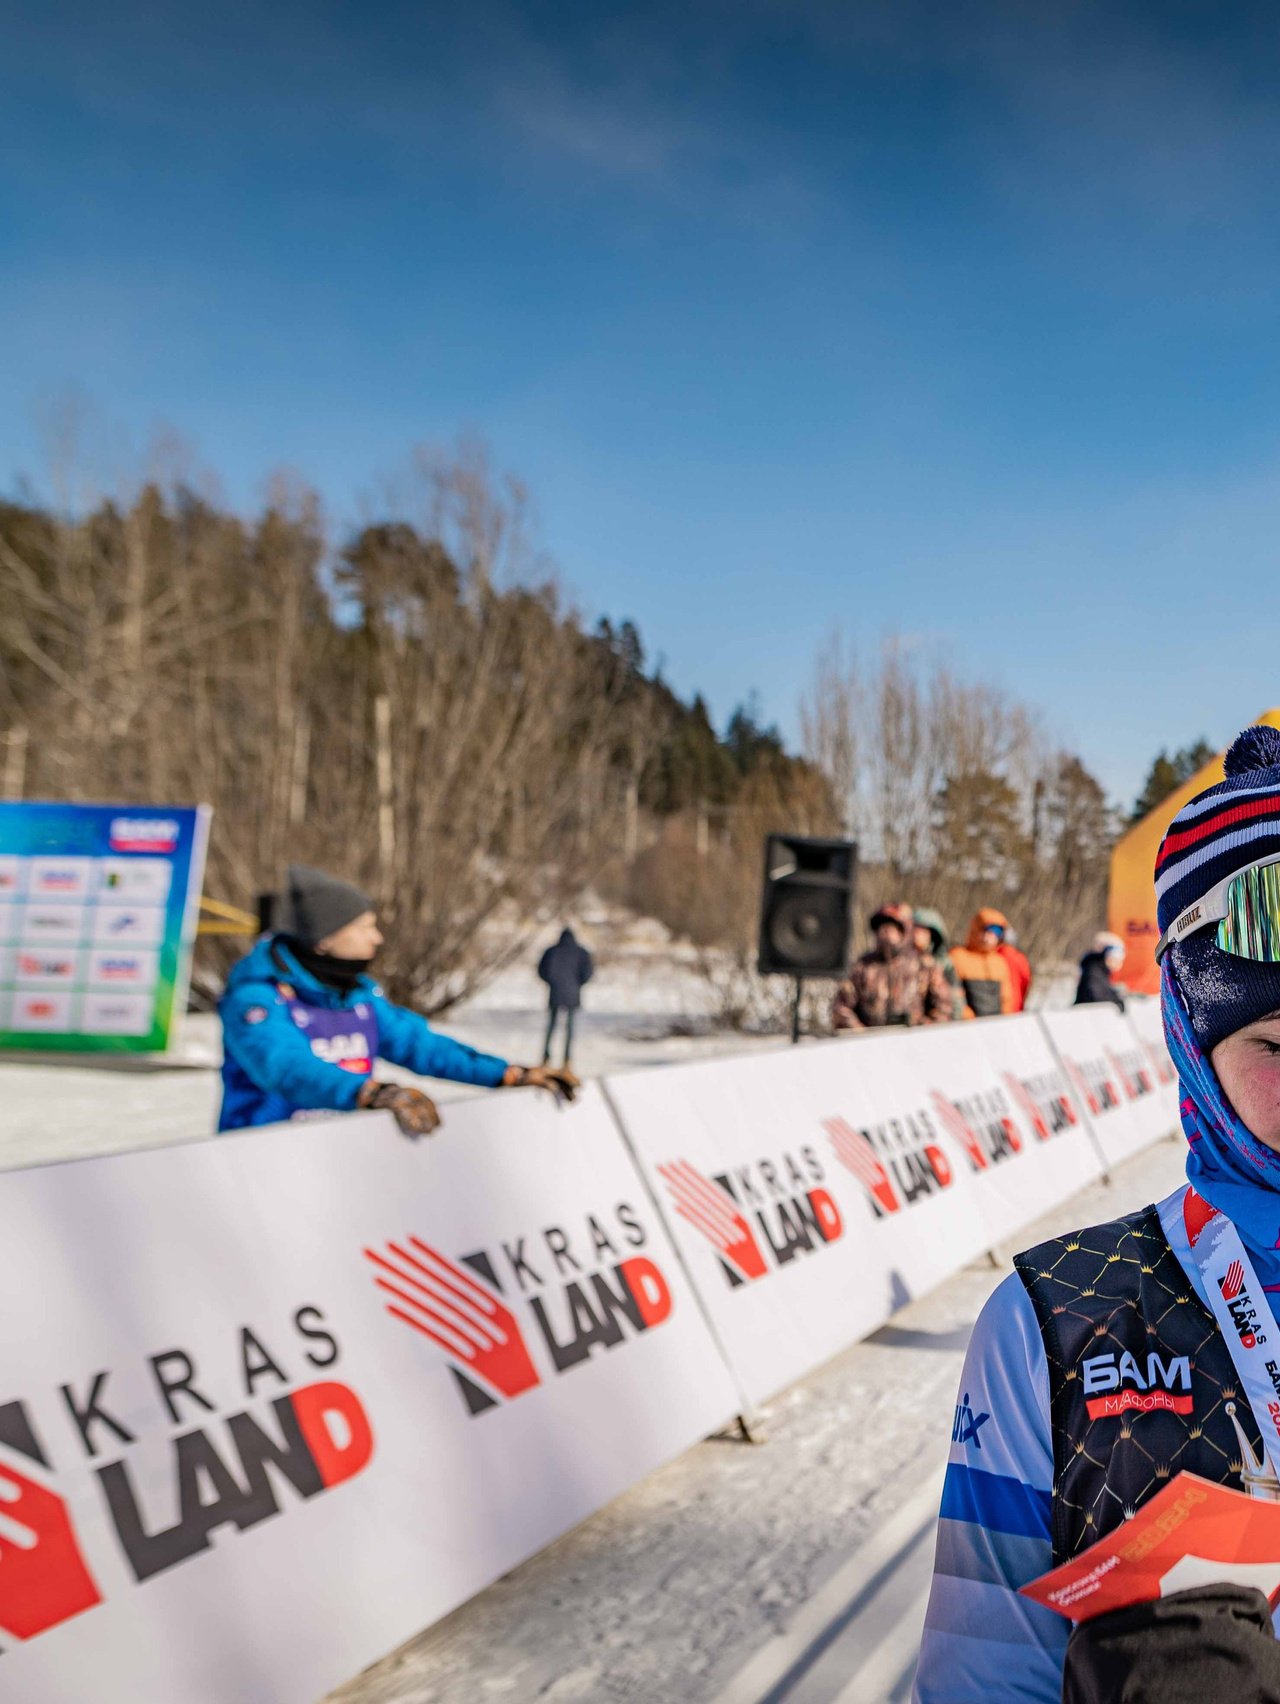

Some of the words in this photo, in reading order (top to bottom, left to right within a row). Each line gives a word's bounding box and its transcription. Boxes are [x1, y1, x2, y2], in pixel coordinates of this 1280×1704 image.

[735, 1144, 825, 1205] KRAS
[501, 1201, 648, 1291] KRAS
[756, 1188, 843, 1266] LAND
[529, 1256, 673, 1374] LAND
[1227, 1299, 1257, 1349] LAND
[1241, 1296, 1267, 1345] KRAS
[59, 1305, 340, 1458] KRAS
[1083, 1350, 1192, 1395] БАМ
[97, 1381, 374, 1584] LAND
